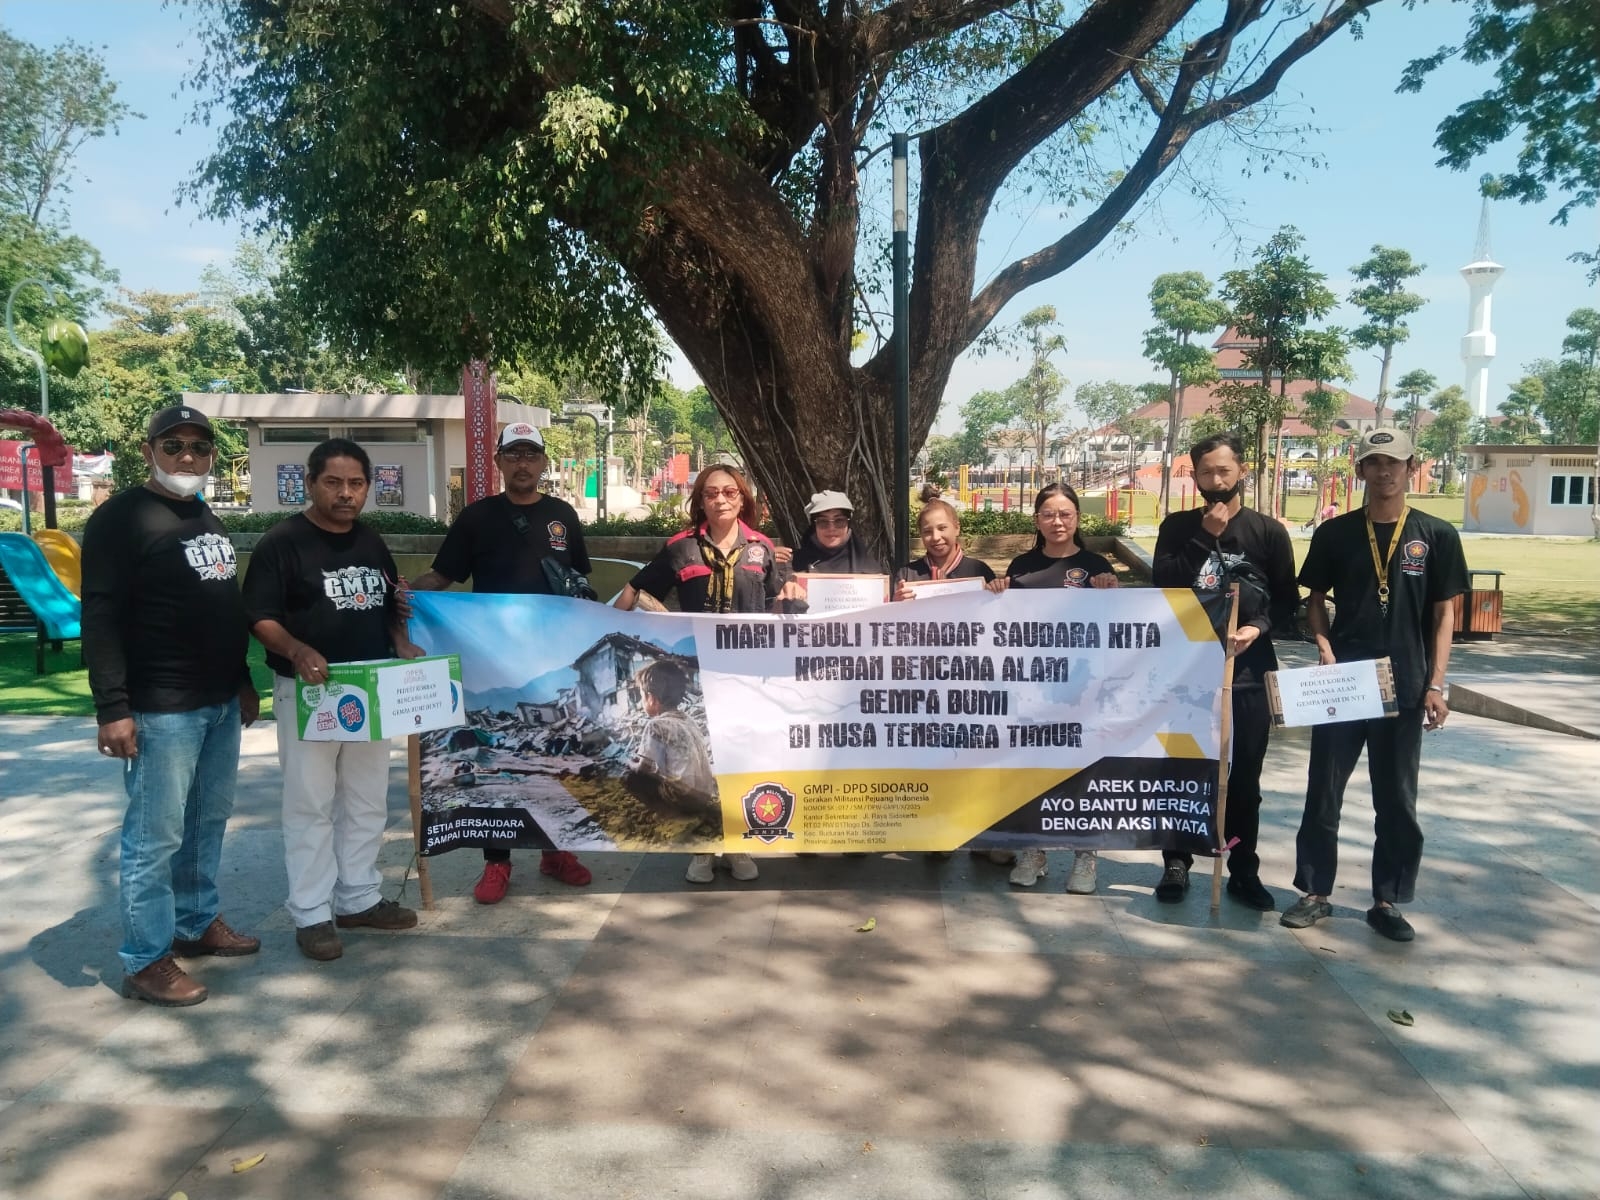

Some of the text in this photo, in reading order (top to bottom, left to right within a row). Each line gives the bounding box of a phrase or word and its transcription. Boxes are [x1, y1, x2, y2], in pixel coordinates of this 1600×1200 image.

[323, 576, 387, 598] GMPI
[715, 621, 1161, 650] MARI PEDULI TERHADAP SAUDARA KITA
[795, 655, 1069, 683] KORBAN BENCANA ALAM
[1327, 676, 1357, 685] KORBAN
[1302, 685, 1357, 697] BENCANA ALAM
[860, 689, 1008, 716] GEMPA BUMI
[1296, 698, 1320, 708] GEMPA
[789, 722, 1083, 749] DI NUSA TENGGARA TIMUR
[803, 783, 833, 795] GMPI
[843, 783, 868, 794] DPD
[870, 782, 929, 794] SIDOARJO
[1087, 779, 1135, 793] AREK
[1139, 779, 1199, 794] DARJO
[865, 795, 894, 804] Pejuang
[895, 794, 930, 802] Indonesia
[1040, 798, 1211, 817] AYO BANTU MEREKA
[426, 818, 525, 836] SETIA BERSAUDARA
[1041, 817, 1209, 836] DENGAN AKSI NYATA
[426, 829, 517, 848] SAMPAI URAT NADI
